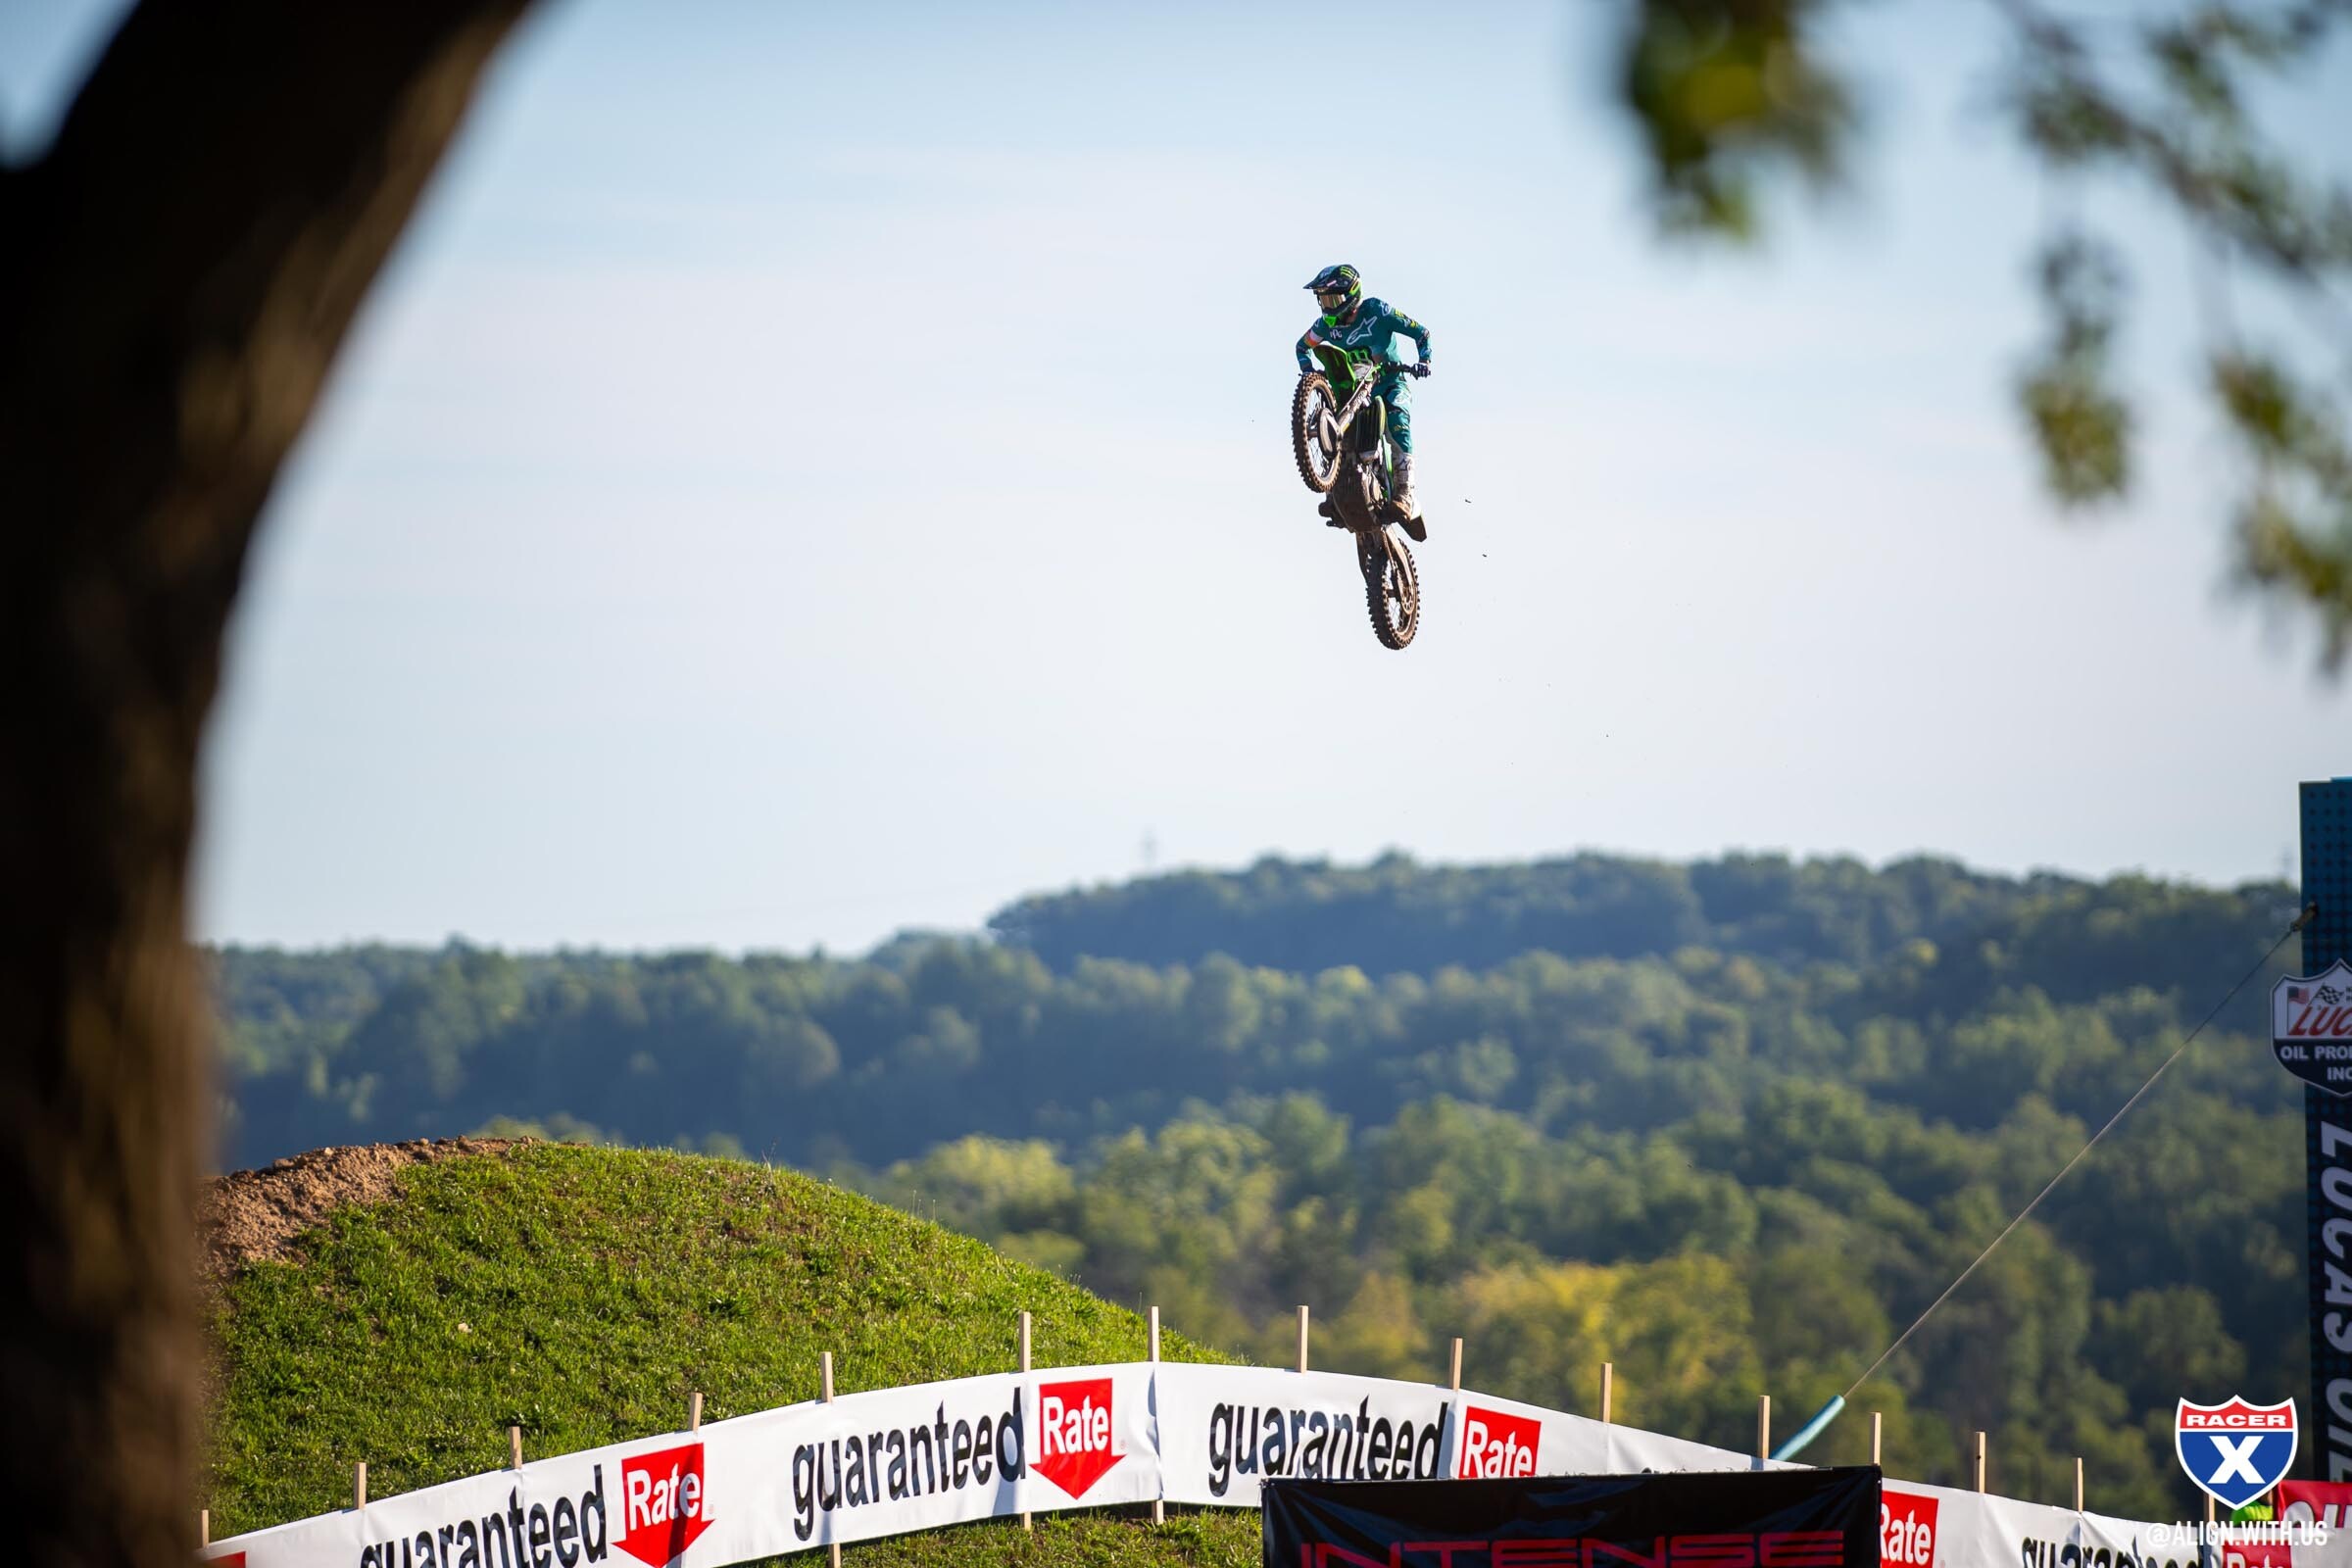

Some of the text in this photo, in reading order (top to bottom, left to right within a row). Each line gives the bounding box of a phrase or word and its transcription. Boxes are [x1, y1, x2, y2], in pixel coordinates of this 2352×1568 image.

[2279, 1046, 2352, 1059] OIL PRO
[792, 1387, 1111, 1542] guaranteed Rate
[1208, 1394, 1535, 1497] guaranteed Rate
[626, 1462, 702, 1532] Rate
[1300, 1530, 1844, 1568] INTENSE
